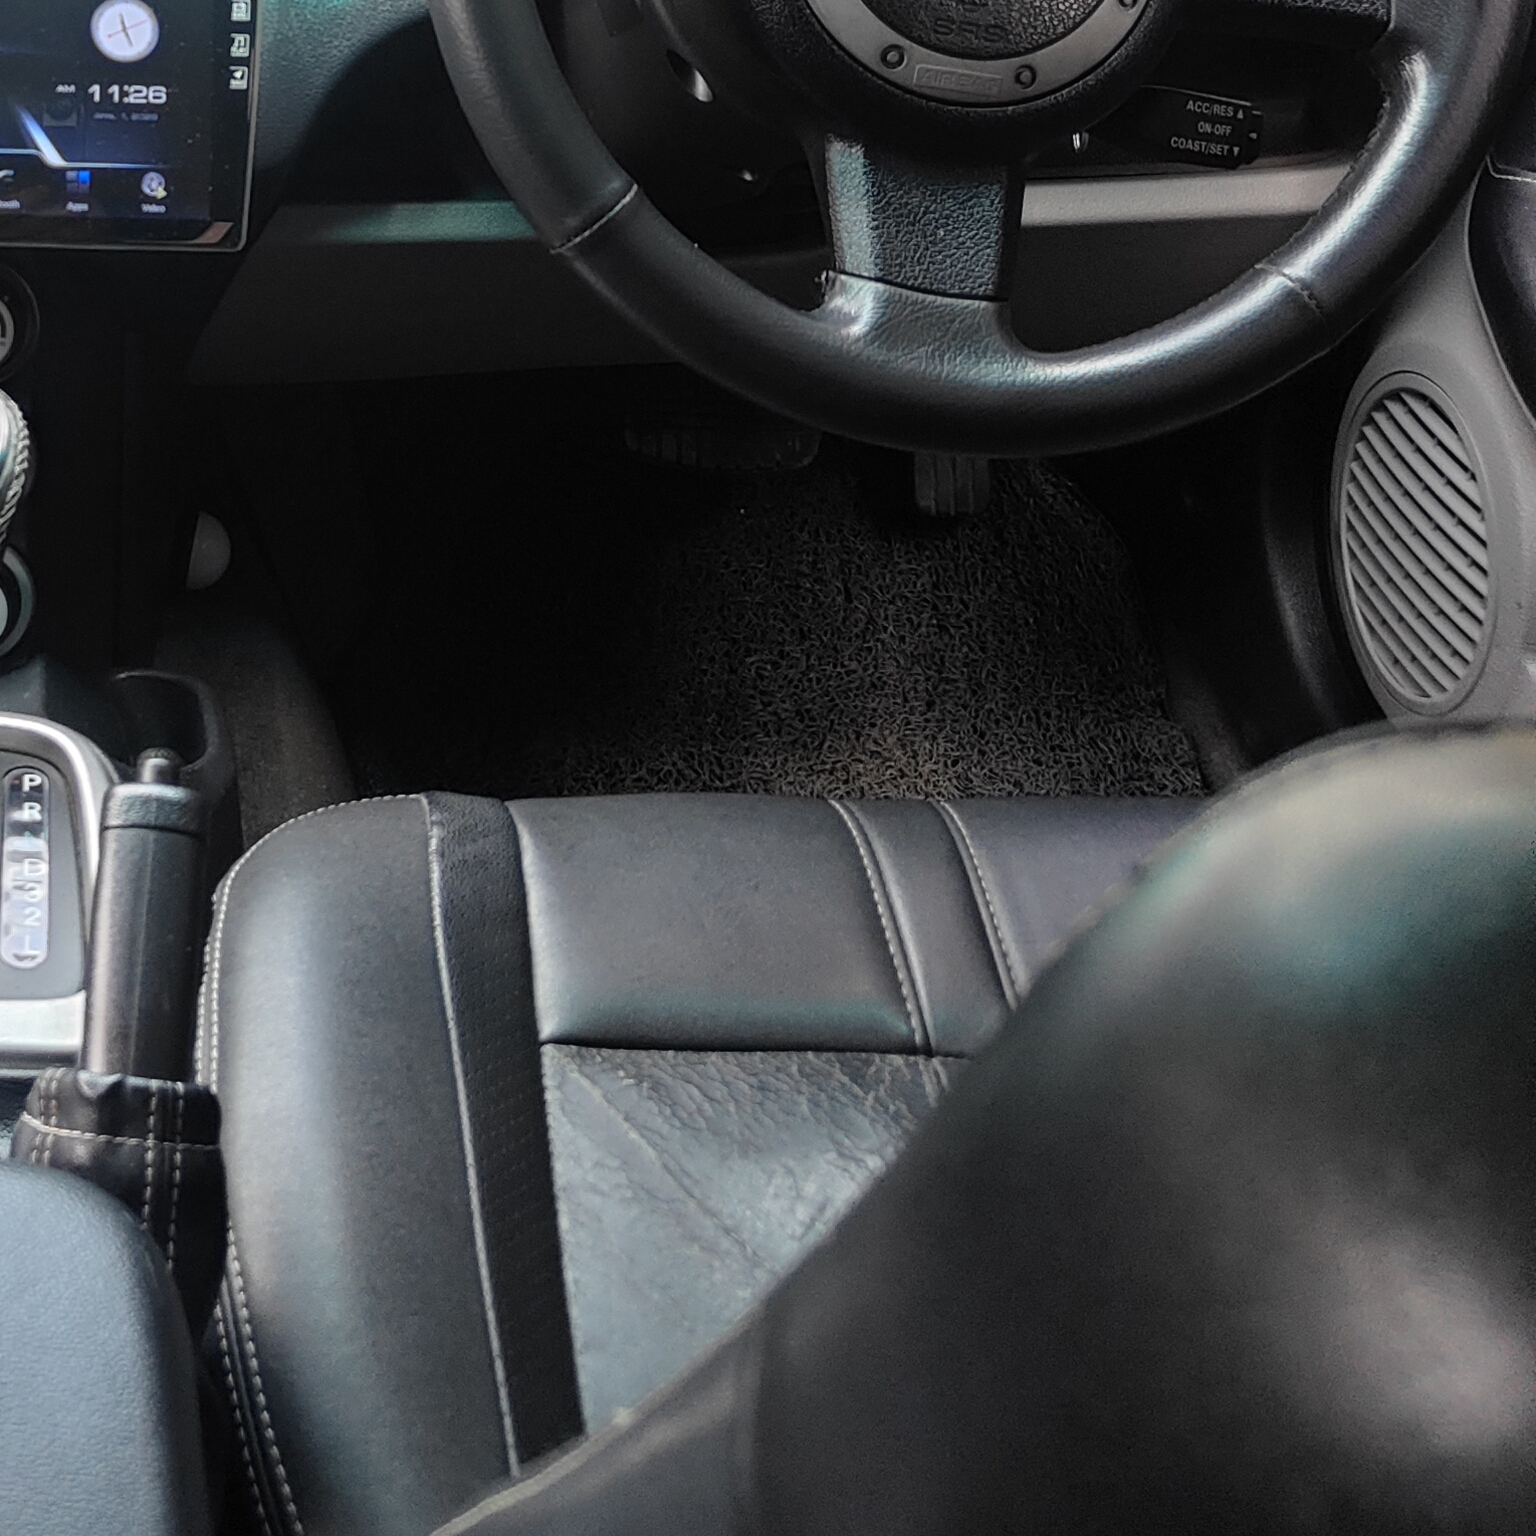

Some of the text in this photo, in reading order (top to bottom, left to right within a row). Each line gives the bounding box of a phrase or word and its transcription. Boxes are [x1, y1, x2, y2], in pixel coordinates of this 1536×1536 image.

[87, 84, 167, 104] 11:26
[1186, 99, 1234, 117] ACC/RES
[1170, 136, 1230, 156] COAST/SET
[22, 774, 43, 792] P
[23, 801, 43, 821] R
[24, 858, 46, 876] D
[24, 883, 42, 902] 3
[24, 907, 41, 926] 2
